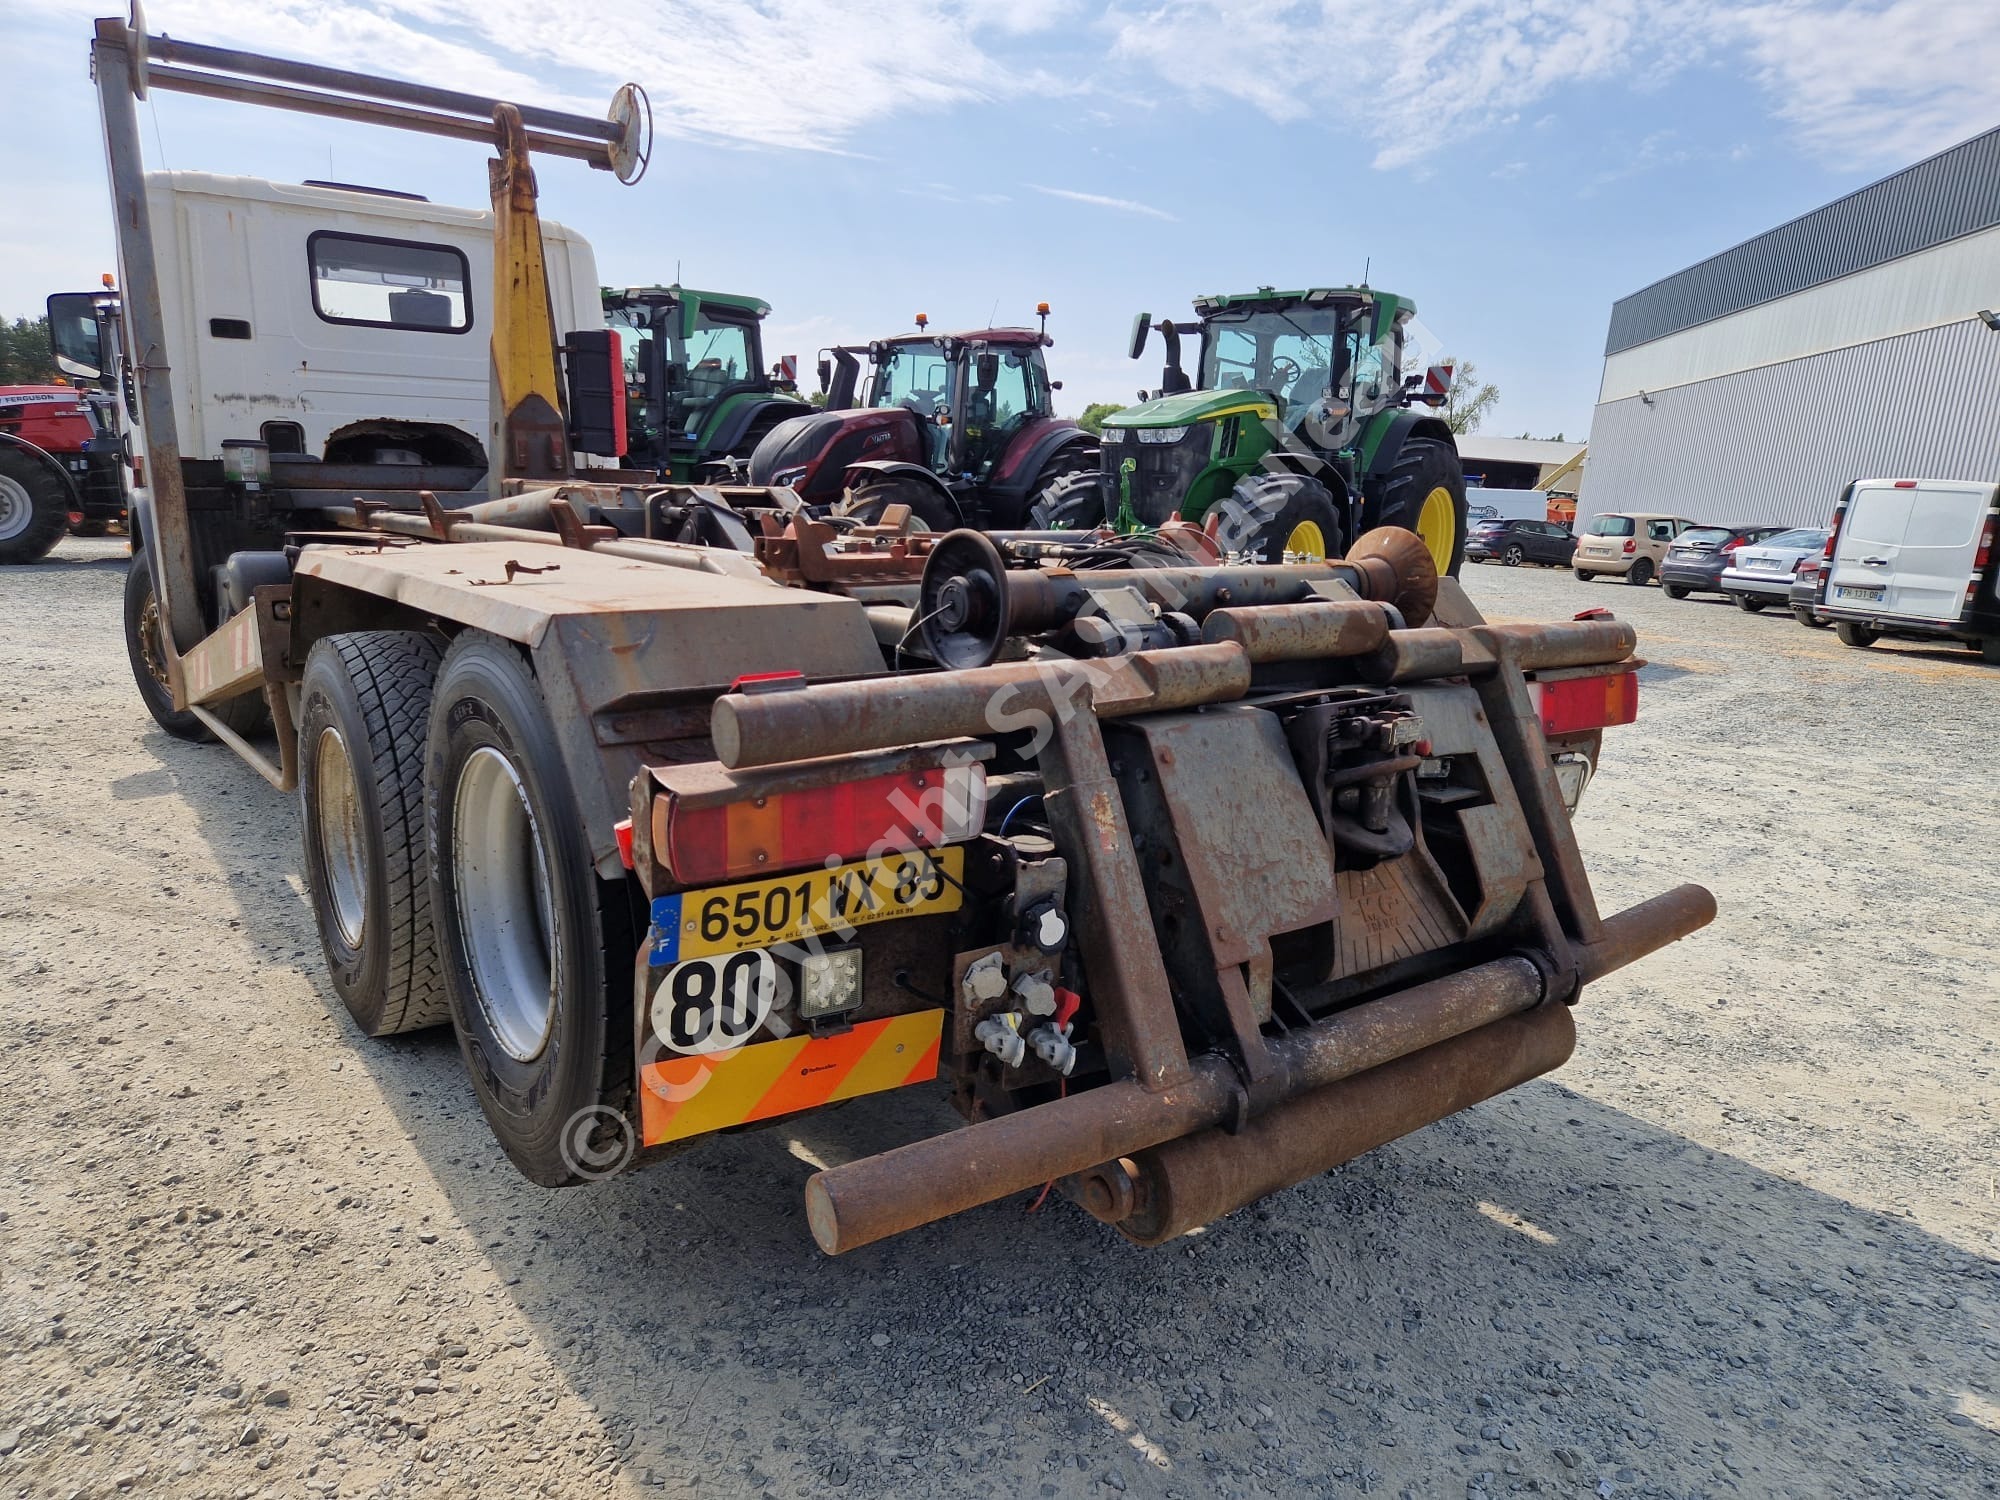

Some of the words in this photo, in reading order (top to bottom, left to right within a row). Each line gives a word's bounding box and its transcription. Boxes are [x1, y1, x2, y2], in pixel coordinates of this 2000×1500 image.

[701, 881, 812, 942] 6501
[829, 866, 879, 919] WX
[893, 856, 945, 904] 85
[659, 937, 670, 952] F
[671, 951, 761, 1047] 80
